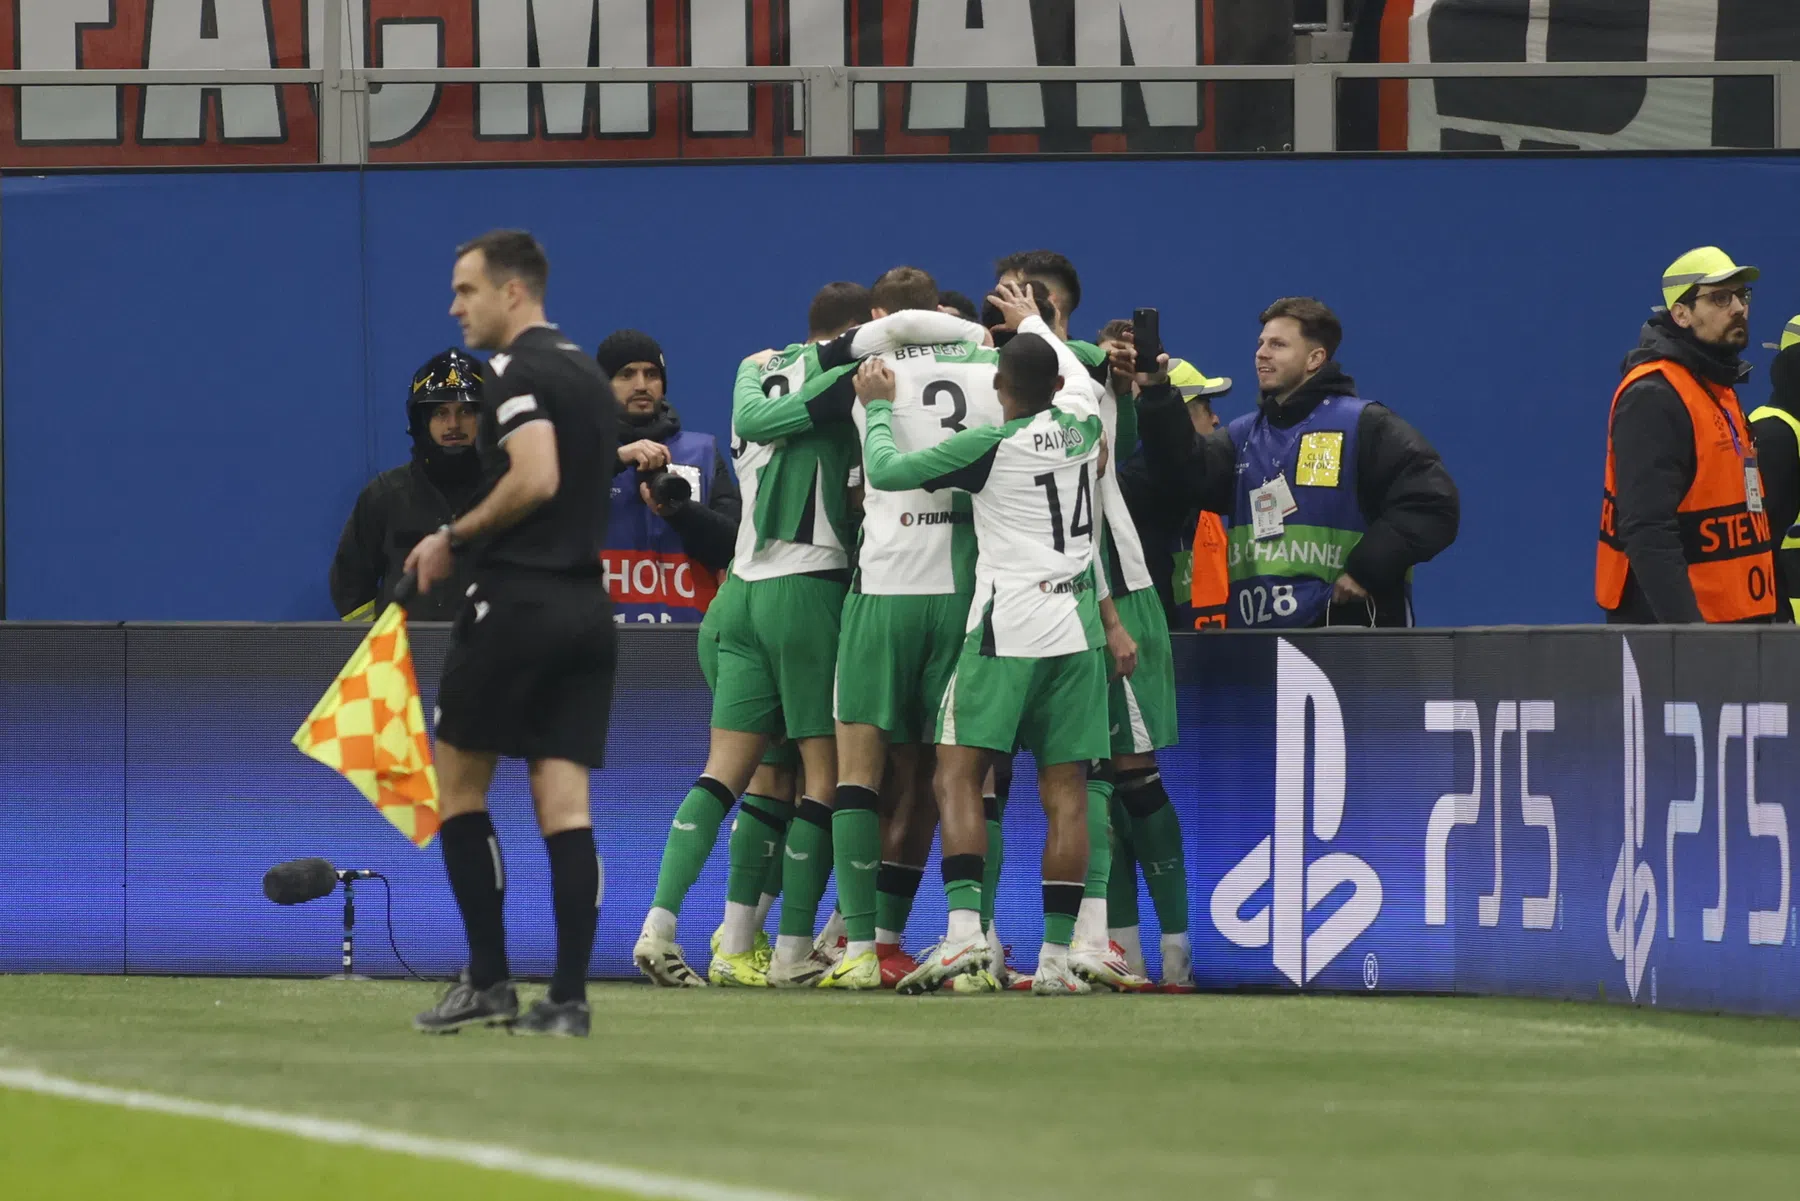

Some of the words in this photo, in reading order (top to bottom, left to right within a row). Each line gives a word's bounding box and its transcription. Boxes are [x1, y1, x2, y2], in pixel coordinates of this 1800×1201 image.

[895, 344, 967, 360] BEELEN
[922, 379, 968, 433] 3
[1034, 462, 1093, 555] 14
[1245, 539, 1344, 569] CHANNEL
[602, 559, 695, 598] HOTO
[1239, 584, 1298, 626] 028
[1424, 700, 1557, 929] PS5
[1664, 701, 1789, 945] PS5
